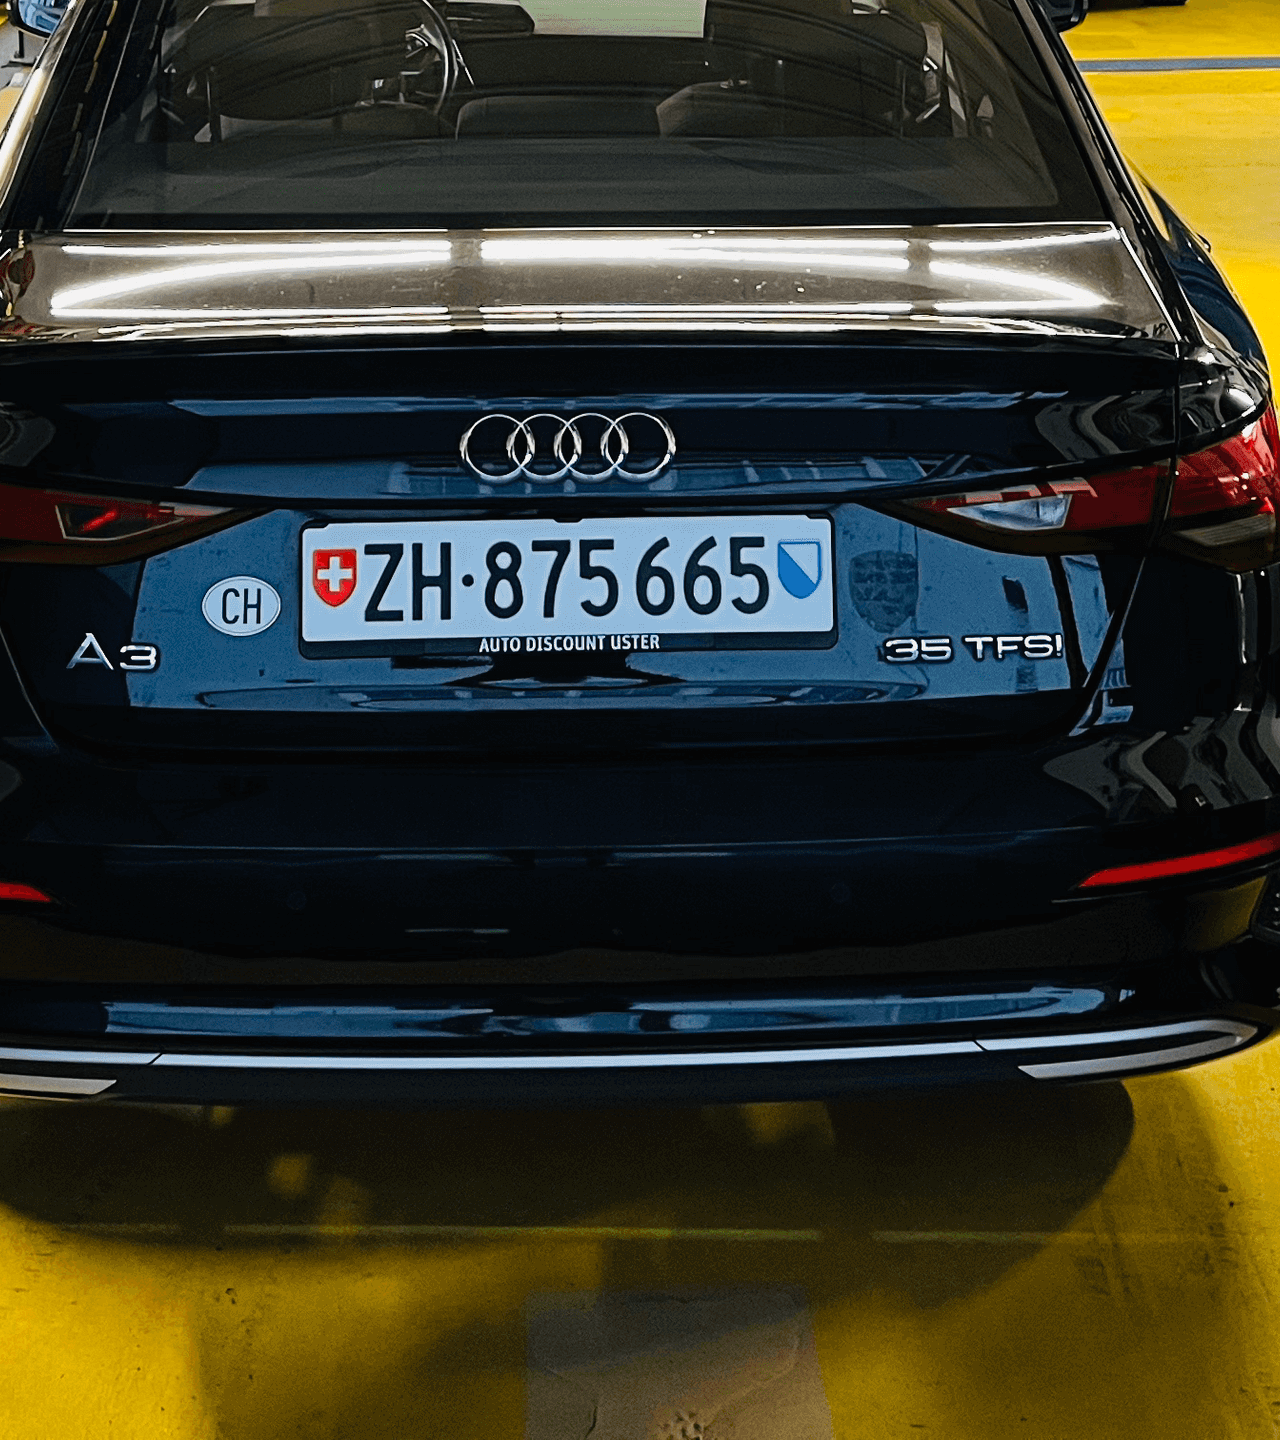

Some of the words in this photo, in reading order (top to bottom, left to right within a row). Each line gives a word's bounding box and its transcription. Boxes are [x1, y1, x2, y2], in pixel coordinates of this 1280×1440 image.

[221, 588, 263, 625] CH
[65, 632, 159, 671] A3
[478, 637, 521, 654] AUTO
[525, 635, 606, 652] DISCOUNT
[610, 634, 661, 651] USTER
[883, 636, 953, 663] 35
